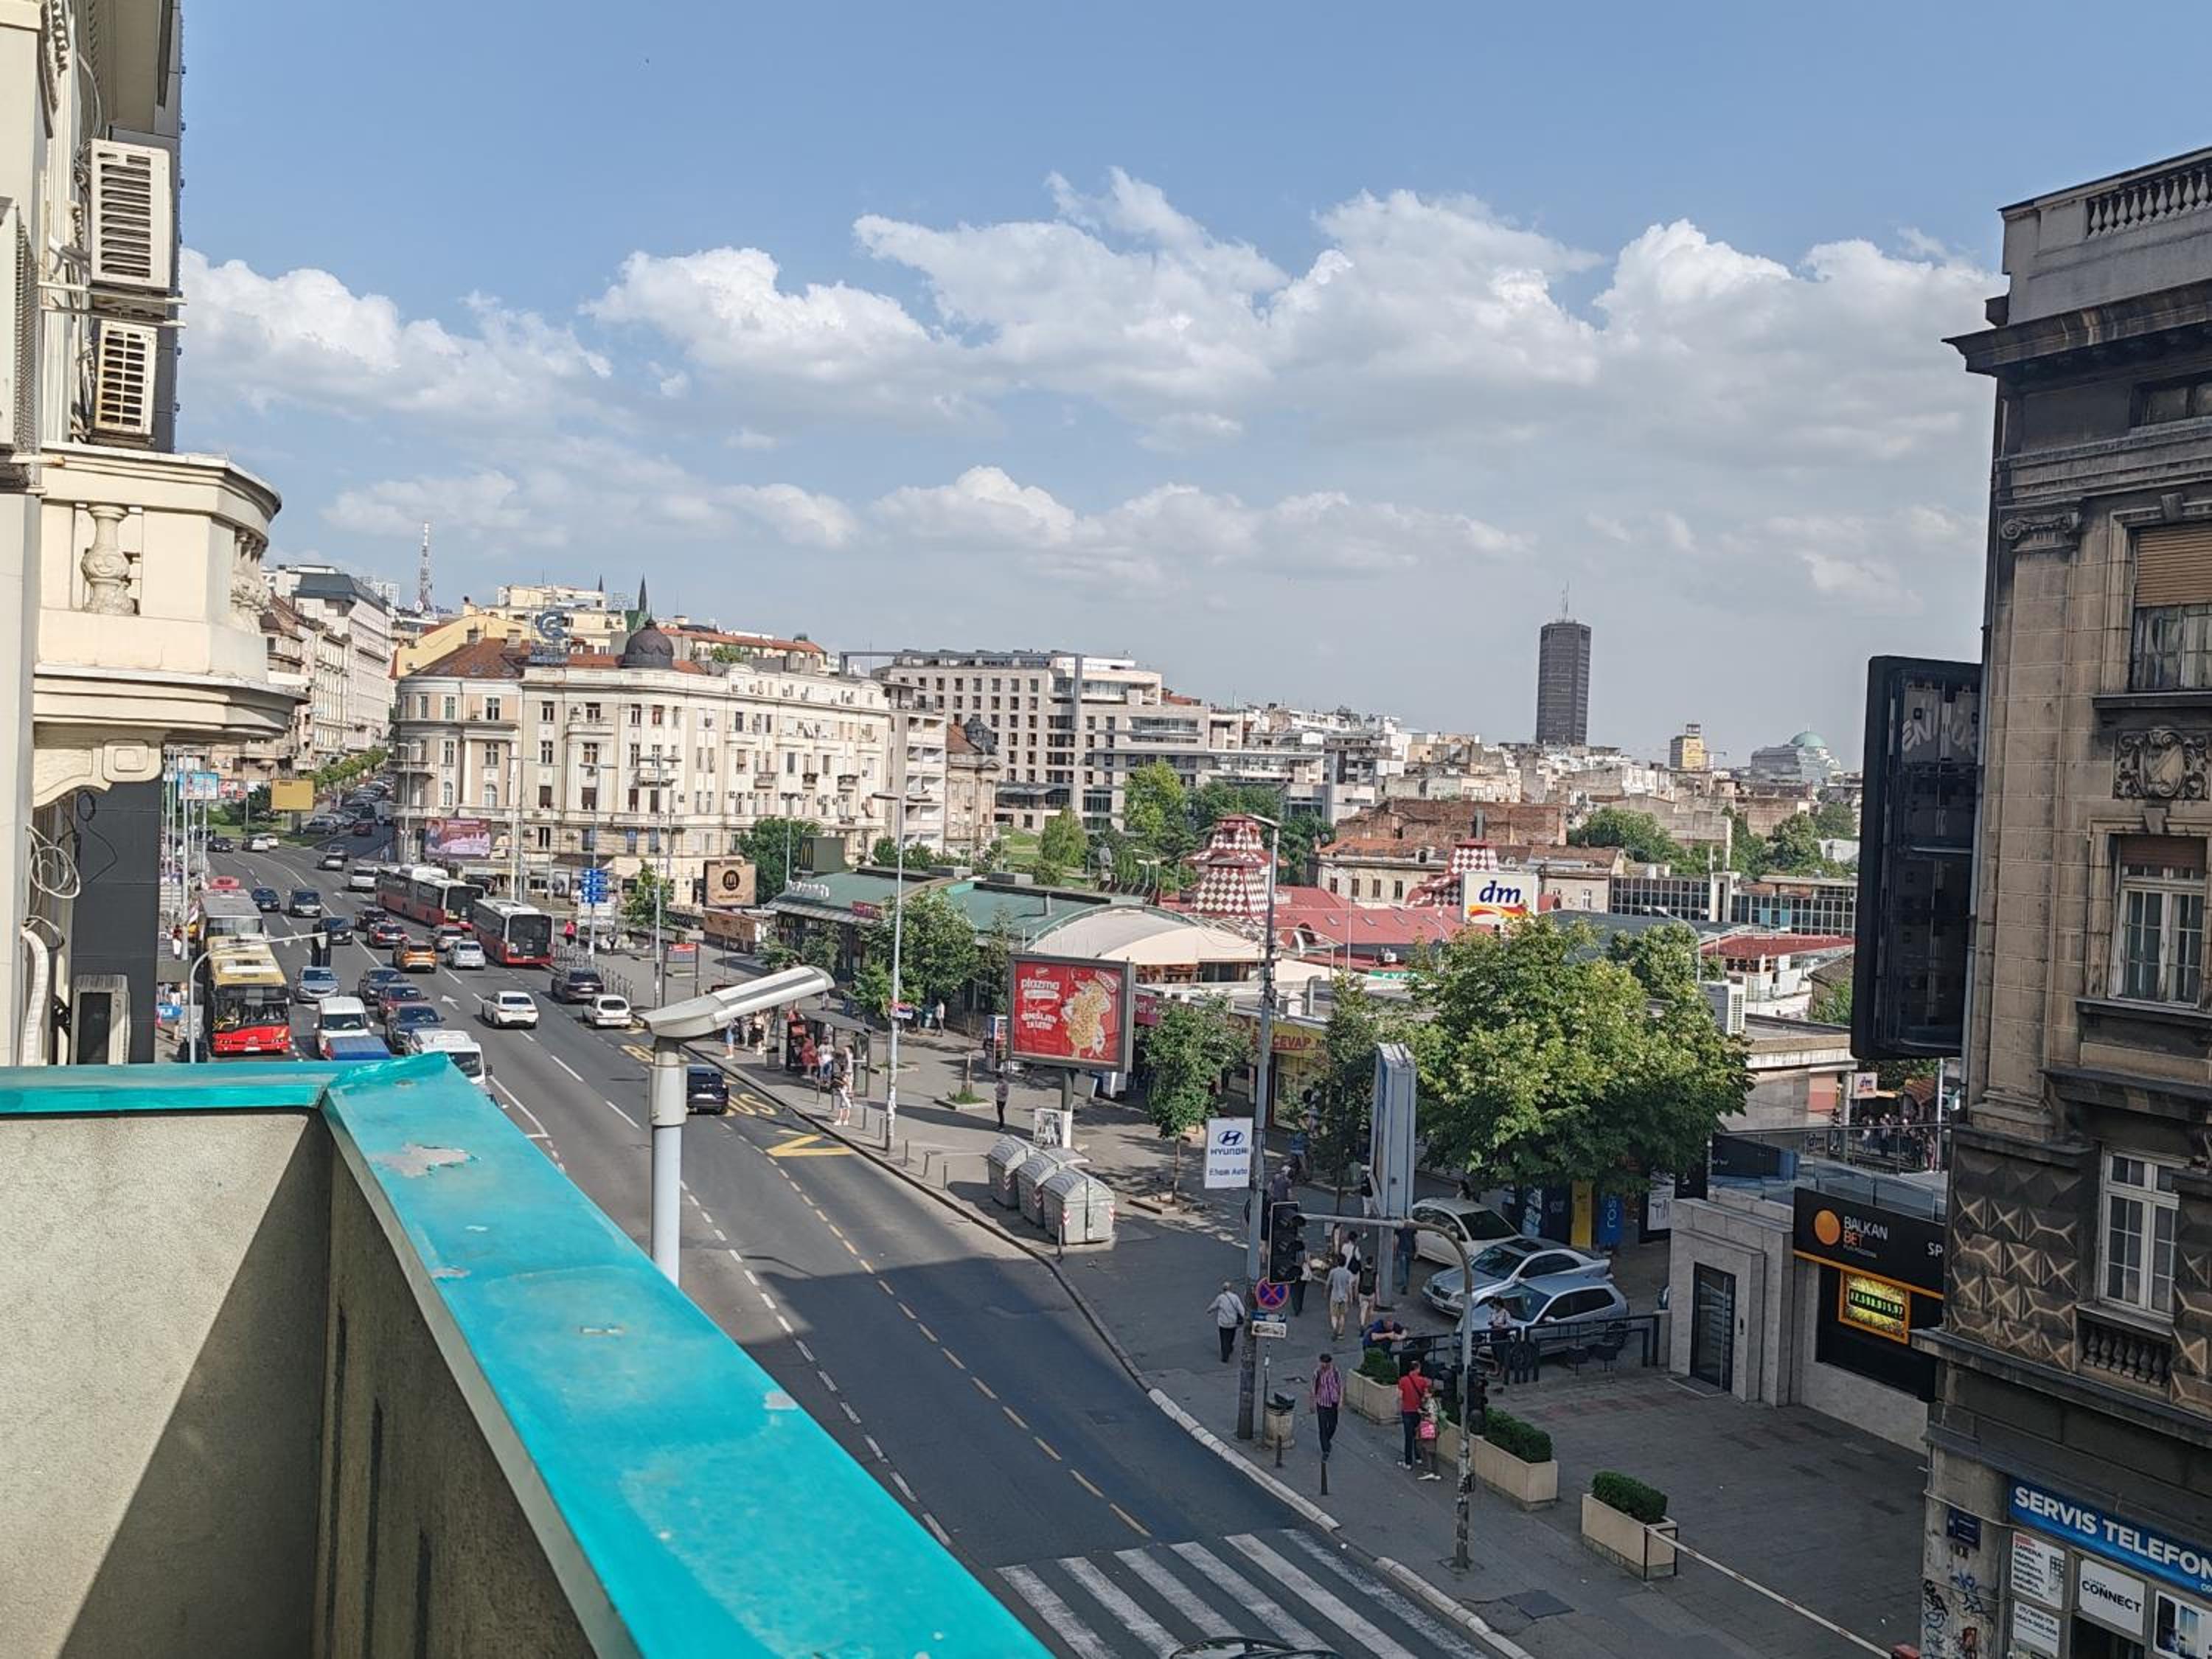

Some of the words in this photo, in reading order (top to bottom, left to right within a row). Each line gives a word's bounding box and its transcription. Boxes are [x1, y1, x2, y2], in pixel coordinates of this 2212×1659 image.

[1479, 880, 1521, 904] dm
[1020, 977, 1060, 990] plazma
[1210, 1147, 1248, 1156] HYUNDAI
[1844, 1216, 1888, 1239] BALKAN
[1844, 1230, 1864, 1248] BET
[2015, 1486, 2098, 1535] SERVIS
[2081, 1580, 2142, 1613] CONNECT
